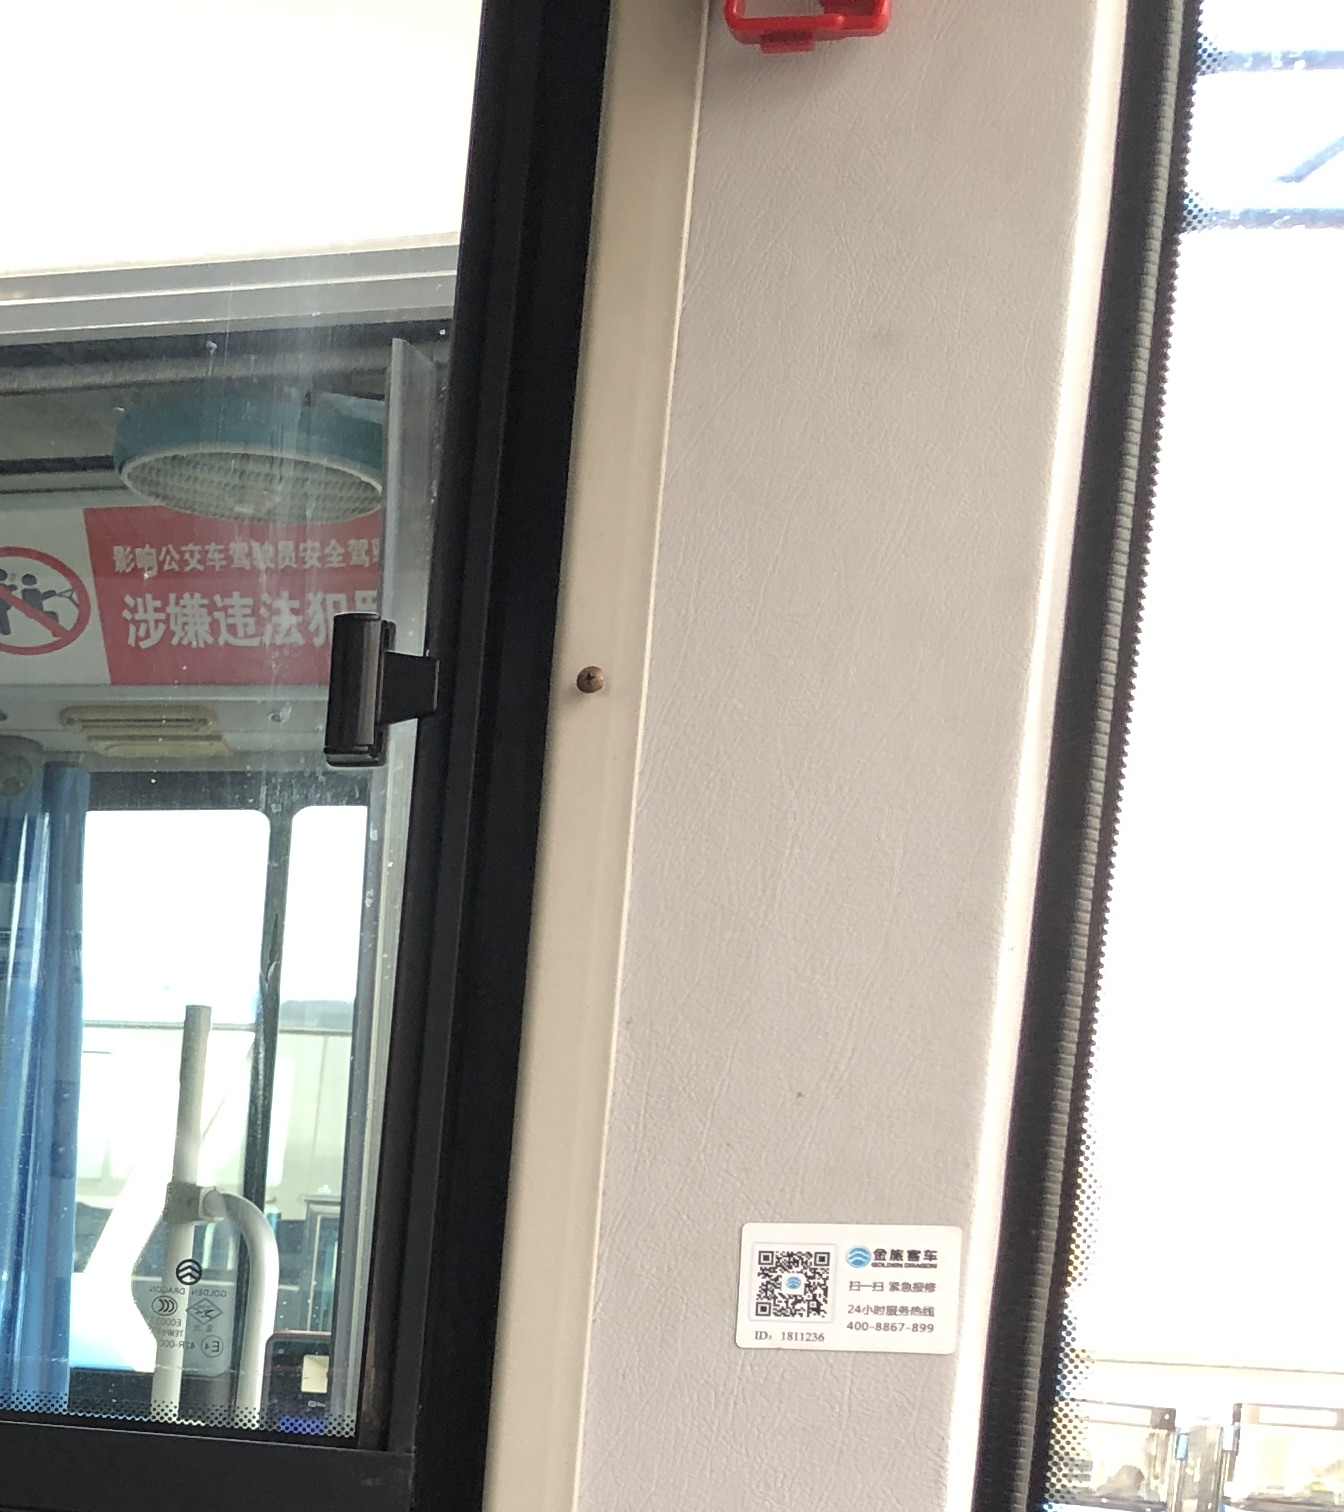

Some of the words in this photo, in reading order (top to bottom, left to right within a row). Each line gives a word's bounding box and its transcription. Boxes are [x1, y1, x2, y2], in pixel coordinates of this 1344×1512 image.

[848, 1280, 884, 1292] 扫一扫
[846, 1321, 935, 1333] 400-8867-899
